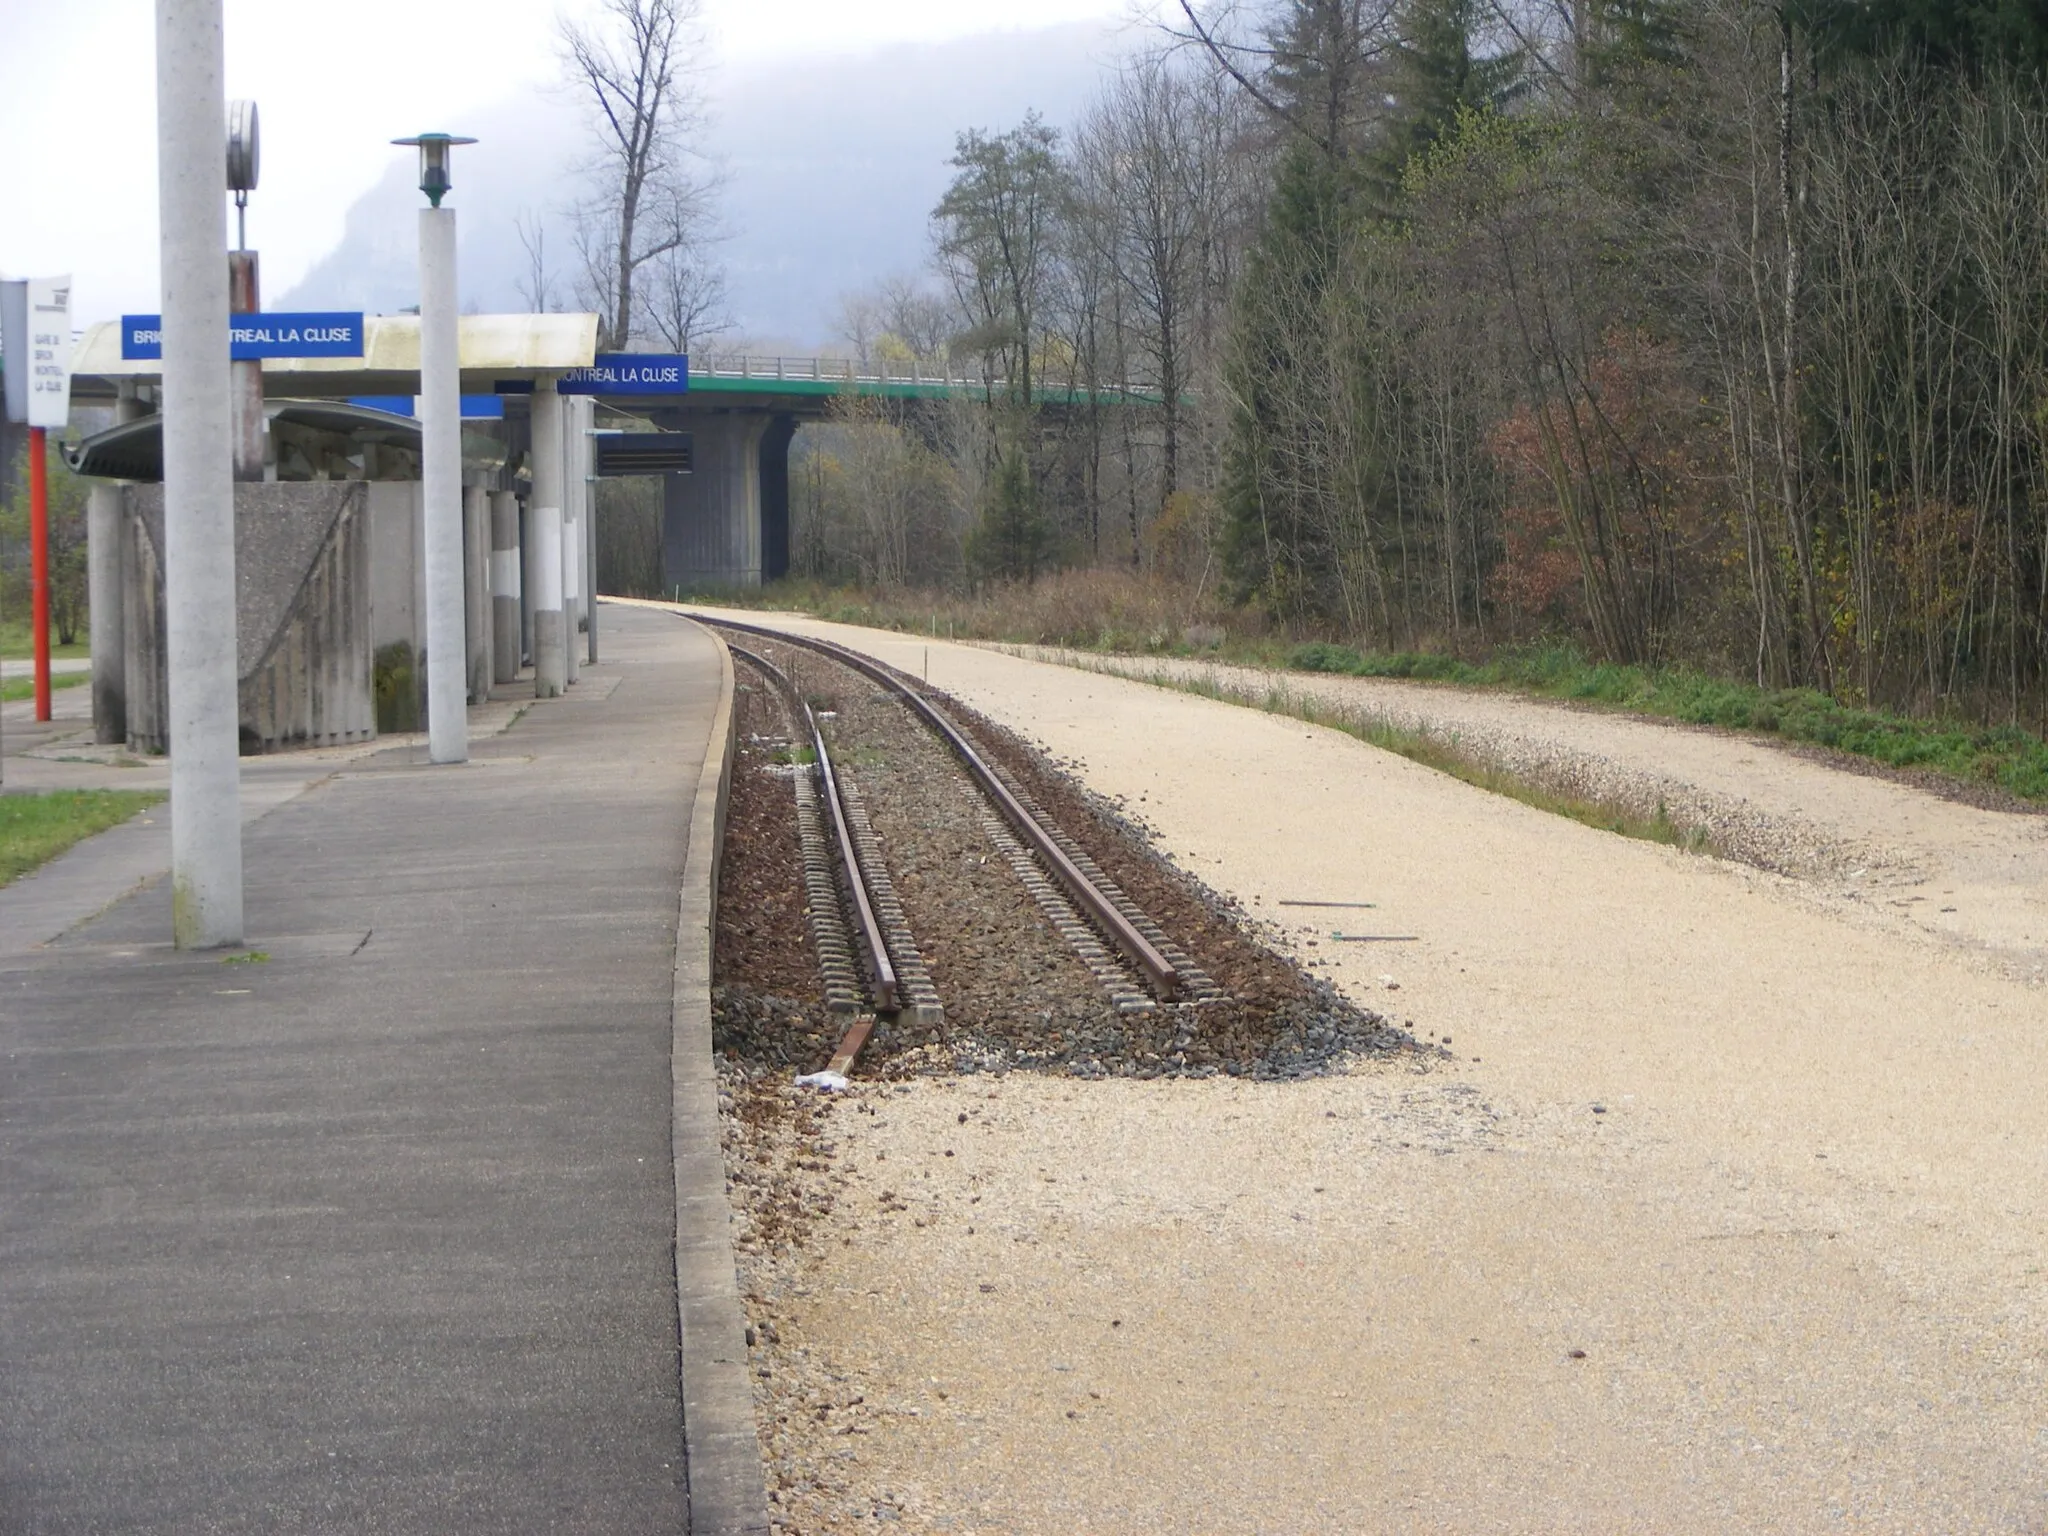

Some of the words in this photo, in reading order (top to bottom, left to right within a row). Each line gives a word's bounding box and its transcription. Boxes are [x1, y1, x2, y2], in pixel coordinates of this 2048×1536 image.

[229, 329, 275, 343] TREAL
[278, 328, 300, 342] LA
[303, 327, 352, 342] CLUSE
[560, 367, 618, 382] ONTREAL
[621, 367, 639, 382] LA
[641, 366, 679, 382] CLUSE
